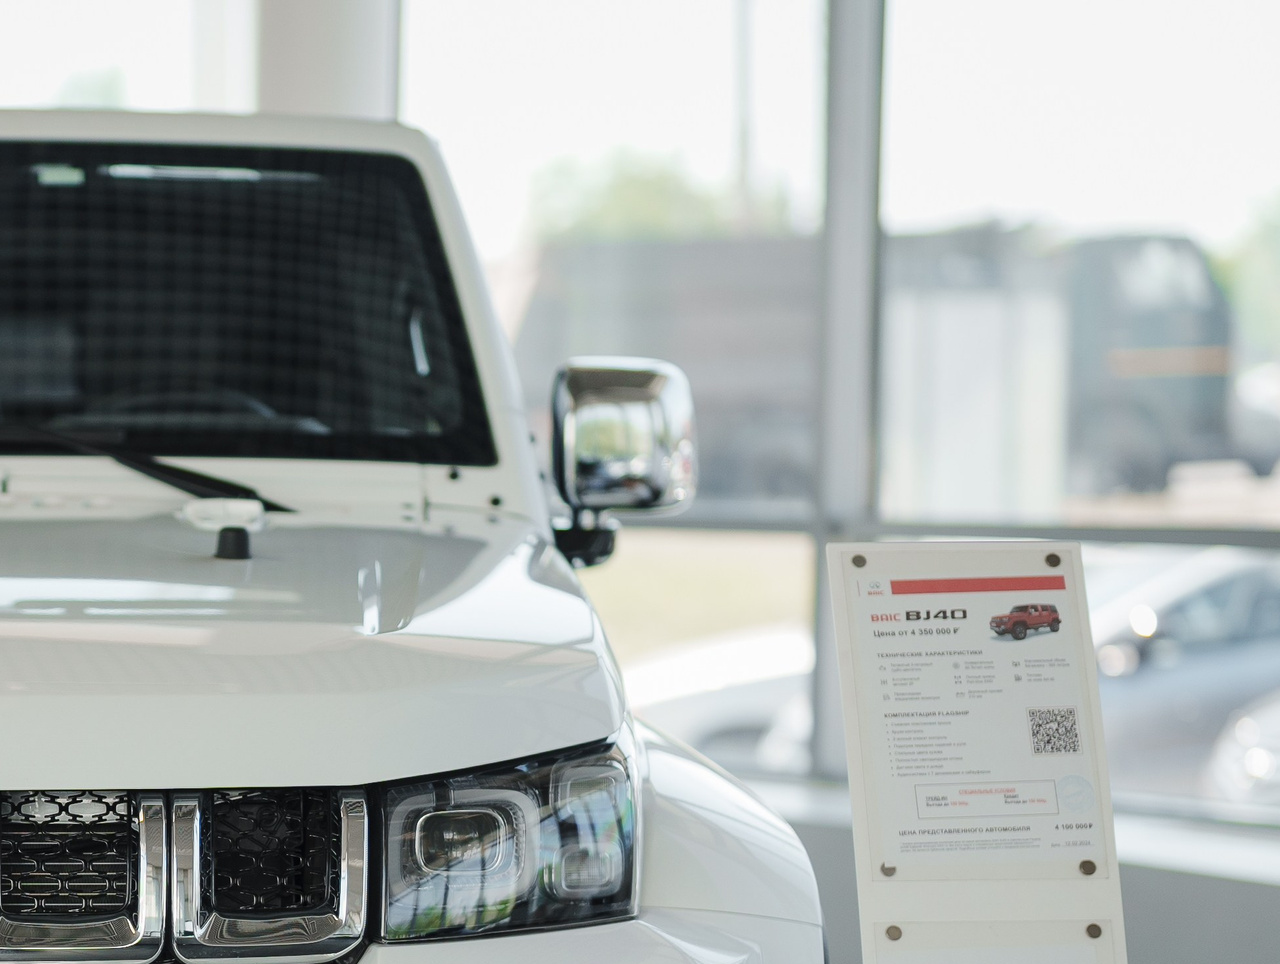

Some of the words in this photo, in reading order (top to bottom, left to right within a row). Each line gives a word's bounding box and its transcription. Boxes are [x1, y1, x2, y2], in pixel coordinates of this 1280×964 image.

[871, 613, 901, 622] BAIC
[905, 609, 967, 621] BJ40
[873, 629, 896, 638] Цена
[918, 827, 984, 835] ПРЕДСТАВЛЕННОГО
[985, 825, 1031, 833] АВТОМОБИЛЯ
